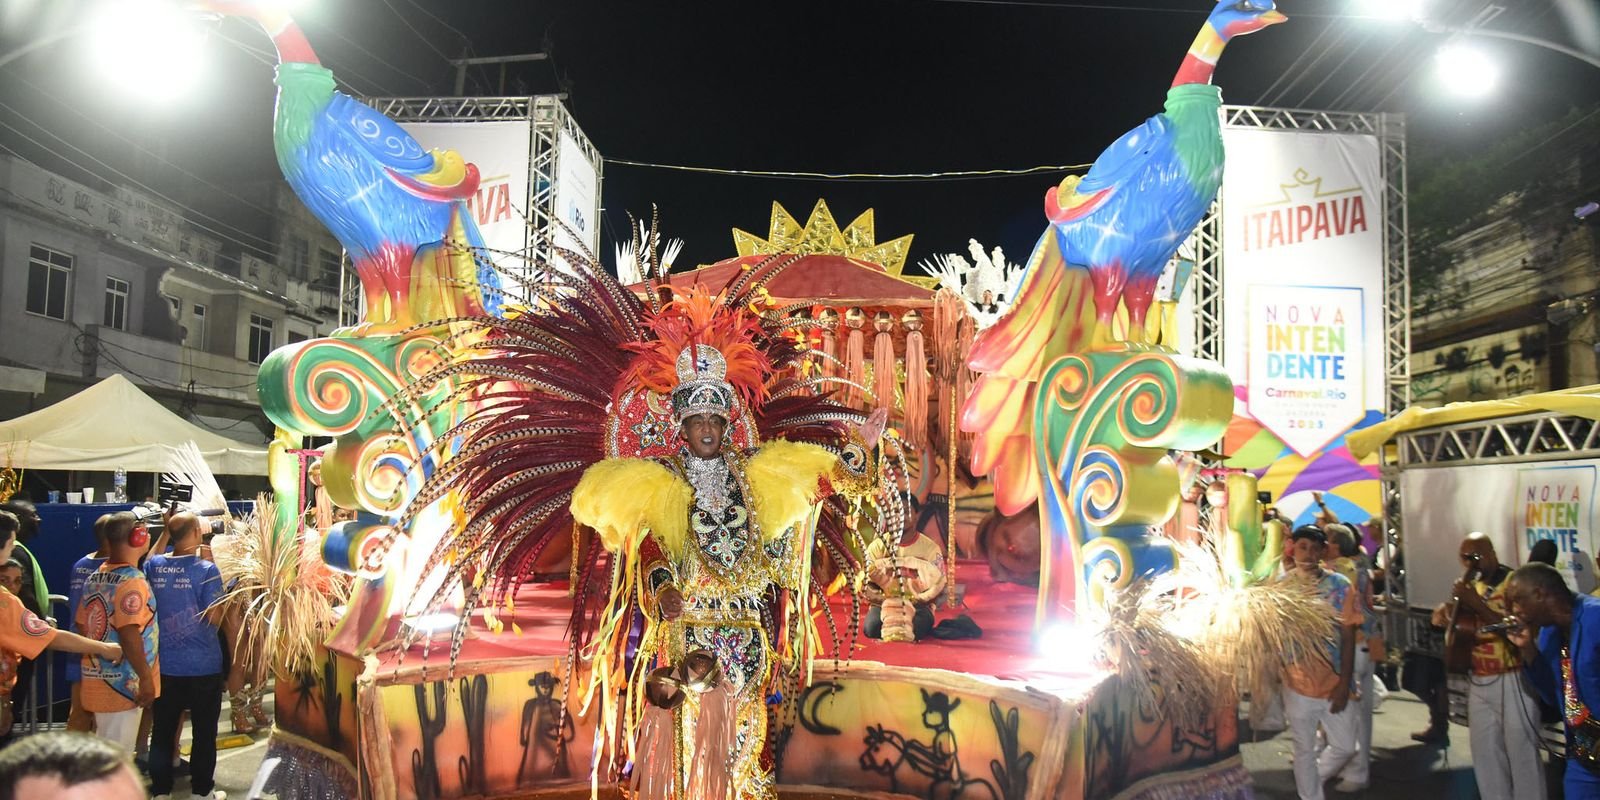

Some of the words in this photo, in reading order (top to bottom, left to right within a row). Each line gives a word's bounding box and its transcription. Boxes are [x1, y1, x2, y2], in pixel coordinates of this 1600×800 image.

[1243, 195, 1368, 251] ITAIPAVA
[1265, 305, 1345, 325] NOVA
[1266, 325, 1345, 352] INTEN
[1266, 354, 1345, 380] DENTE
[1527, 484, 1580, 501] NOVA
[1525, 502, 1580, 528] INTEN
